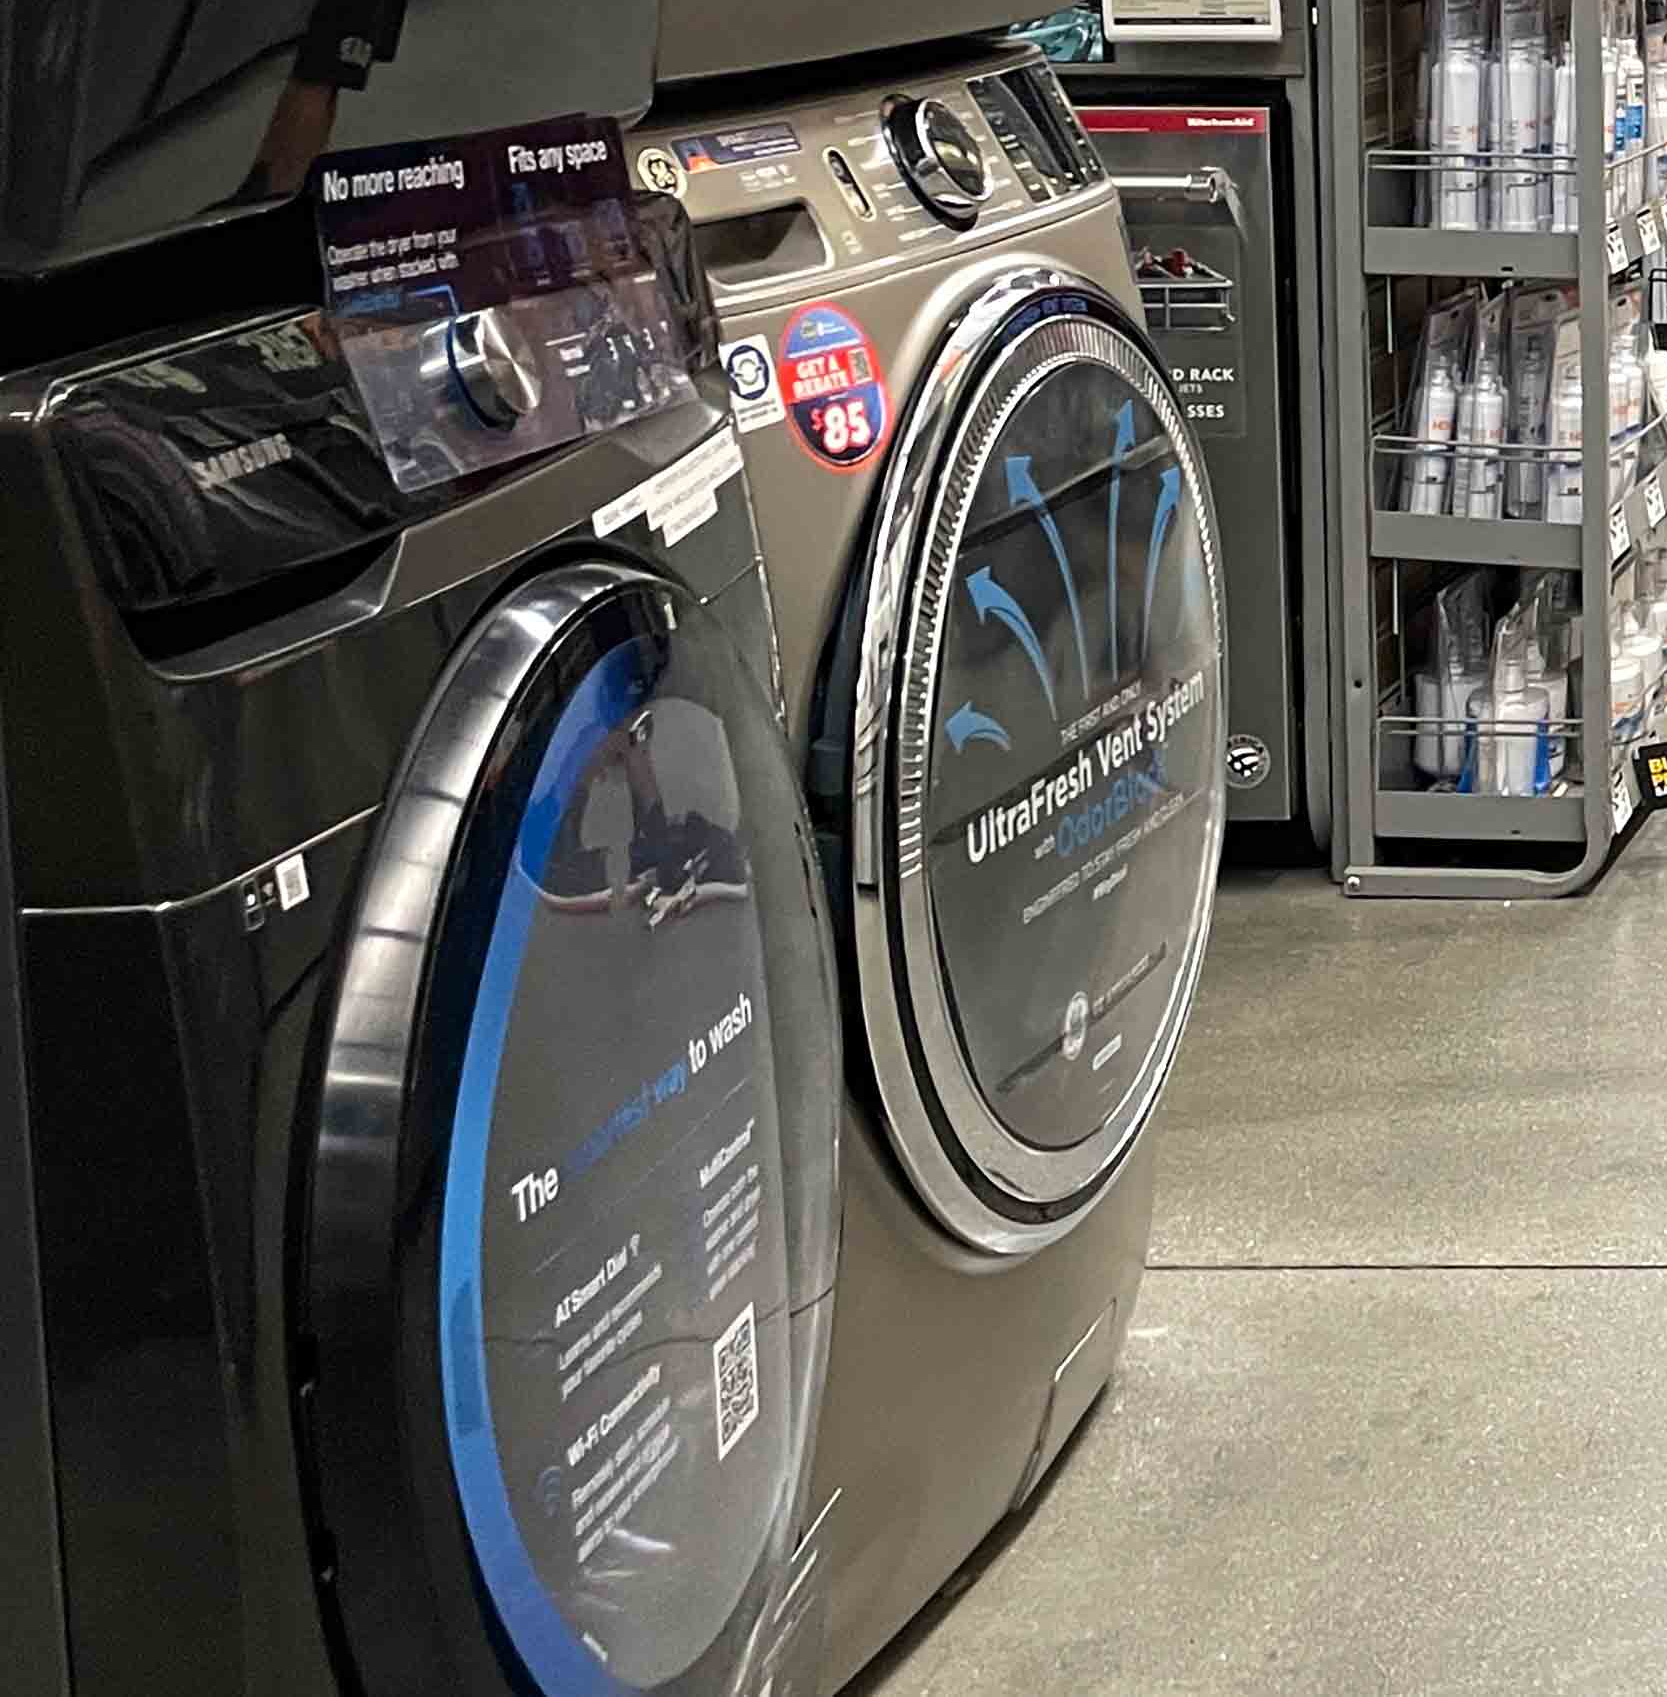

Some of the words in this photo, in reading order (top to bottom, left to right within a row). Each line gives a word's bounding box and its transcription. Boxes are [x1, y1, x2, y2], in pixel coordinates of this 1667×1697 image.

[323, 170, 349, 202] No
[352, 167, 394, 198] more
[398, 155, 465, 191] reaching
[508, 146, 537, 175] Fits
[538, 146, 564, 173] any
[566, 140, 608, 168] space
[792, 370, 848, 399] REBATE
[796, 357, 825, 379] GET
[828, 355, 840, 370] A
[1170, 368, 1185, 381] D
[1190, 368, 1234, 382] RACK
[810, 400, 871, 454] $85
[967, 749, 1093, 863] UltraFresh
[1096, 713, 1144, 778] Vent
[1146, 670, 1205, 743] System
[511, 1166, 560, 1223] The
[688, 1038, 708, 1074] to
[708, 992, 752, 1054] wash
[570, 1266, 606, 1313] Smart
[606, 1245, 628, 1281] Dial
[567, 1423, 599, 1467] Wi-Fi
